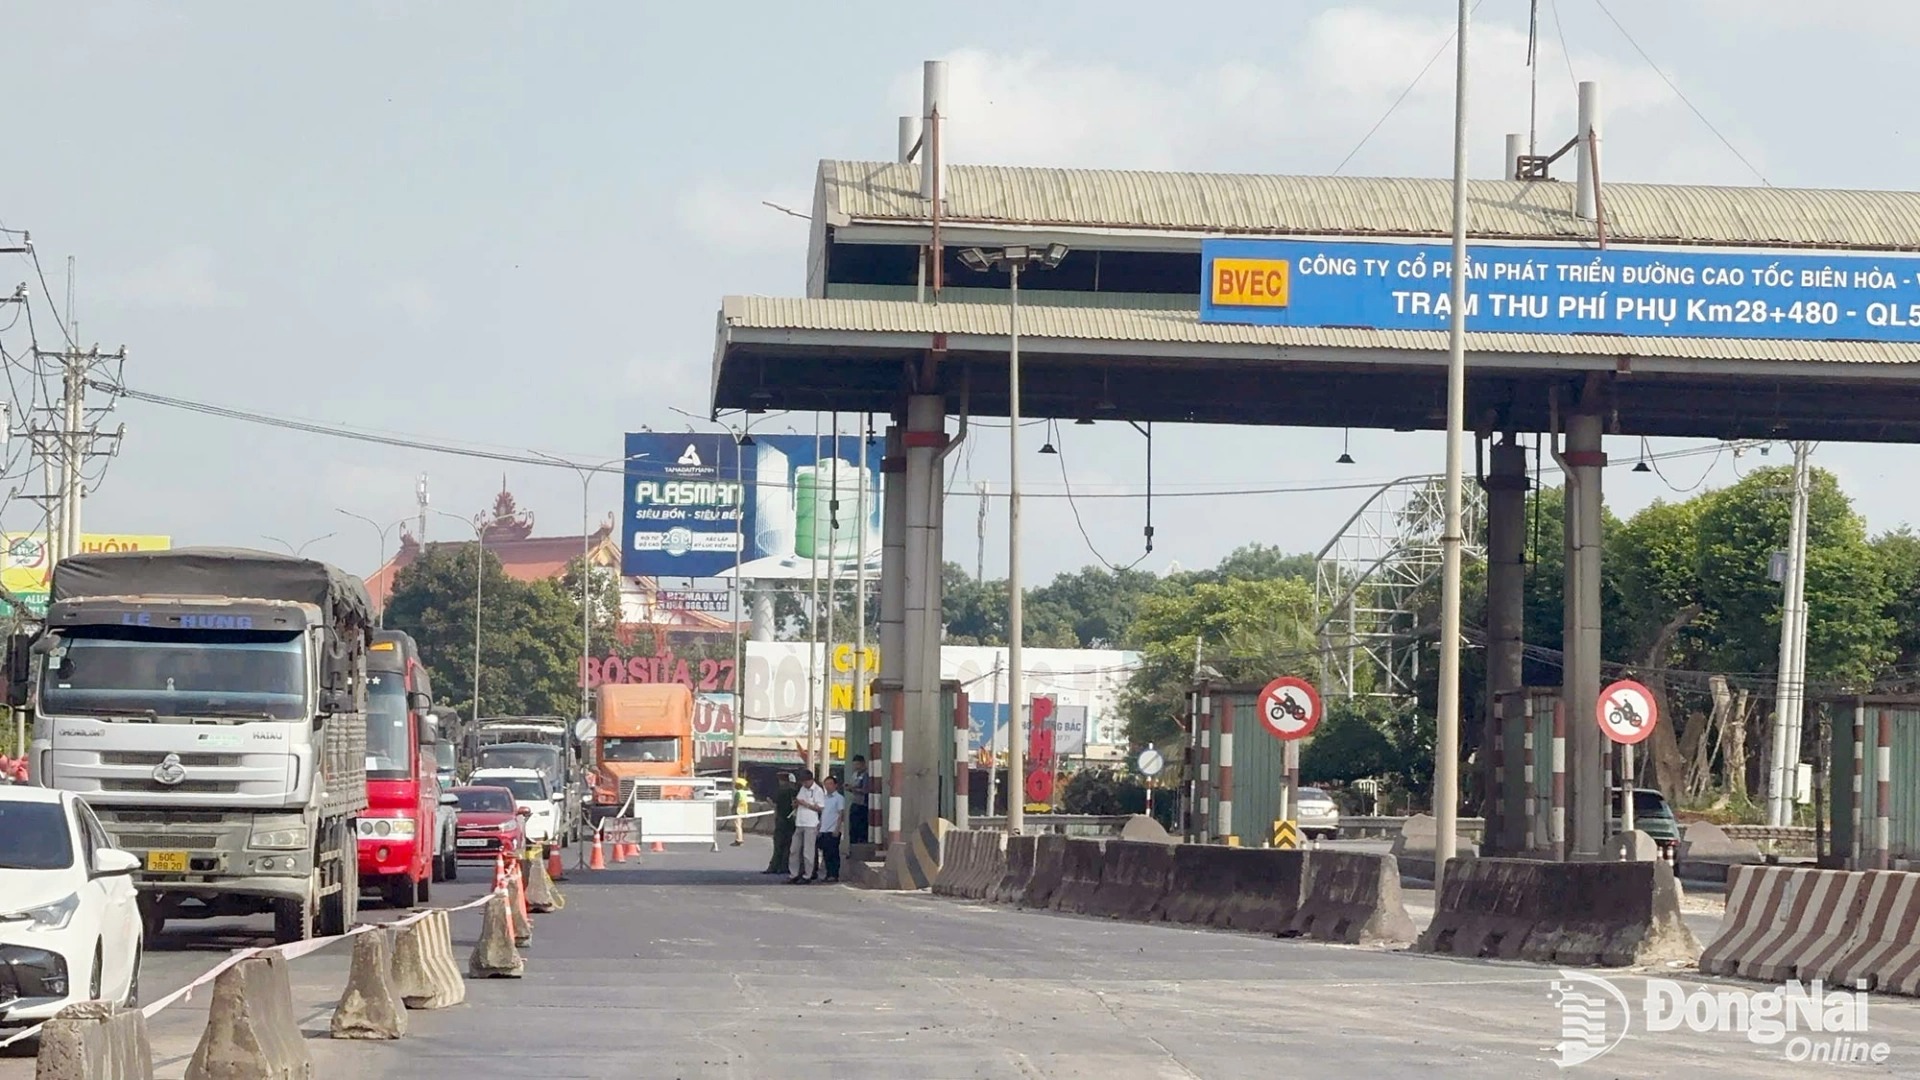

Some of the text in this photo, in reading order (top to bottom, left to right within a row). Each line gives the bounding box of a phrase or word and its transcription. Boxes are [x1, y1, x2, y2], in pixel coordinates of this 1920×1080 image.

[1218, 269, 1282, 297] BVEC
[1298, 254, 1356, 276] CÔNG
[1363, 260, 1389, 276] TY
[1398, 252, 1426, 278] CỔ
[1494, 260, 1549, 280] PHÁT
[1556, 257, 1615, 282] TRIỂN
[1622, 260, 1695, 284] ĐƯỜNG
[1702, 268, 1744, 286] CAO
[1752, 262, 1794, 287] TỐC
[1801, 266, 1846, 288] BIÊN
[1854, 266, 1896, 288] HÒA
[1392, 292, 1478, 320] TRẠM
[1488, 294, 1548, 318] THU
[1559, 291, 1608, 319] PHÍ
[1616, 298, 1676, 327] PHỤ
[1687, 298, 1838, 324] Km28+480
[637, 482, 743, 504] PLASMAN
